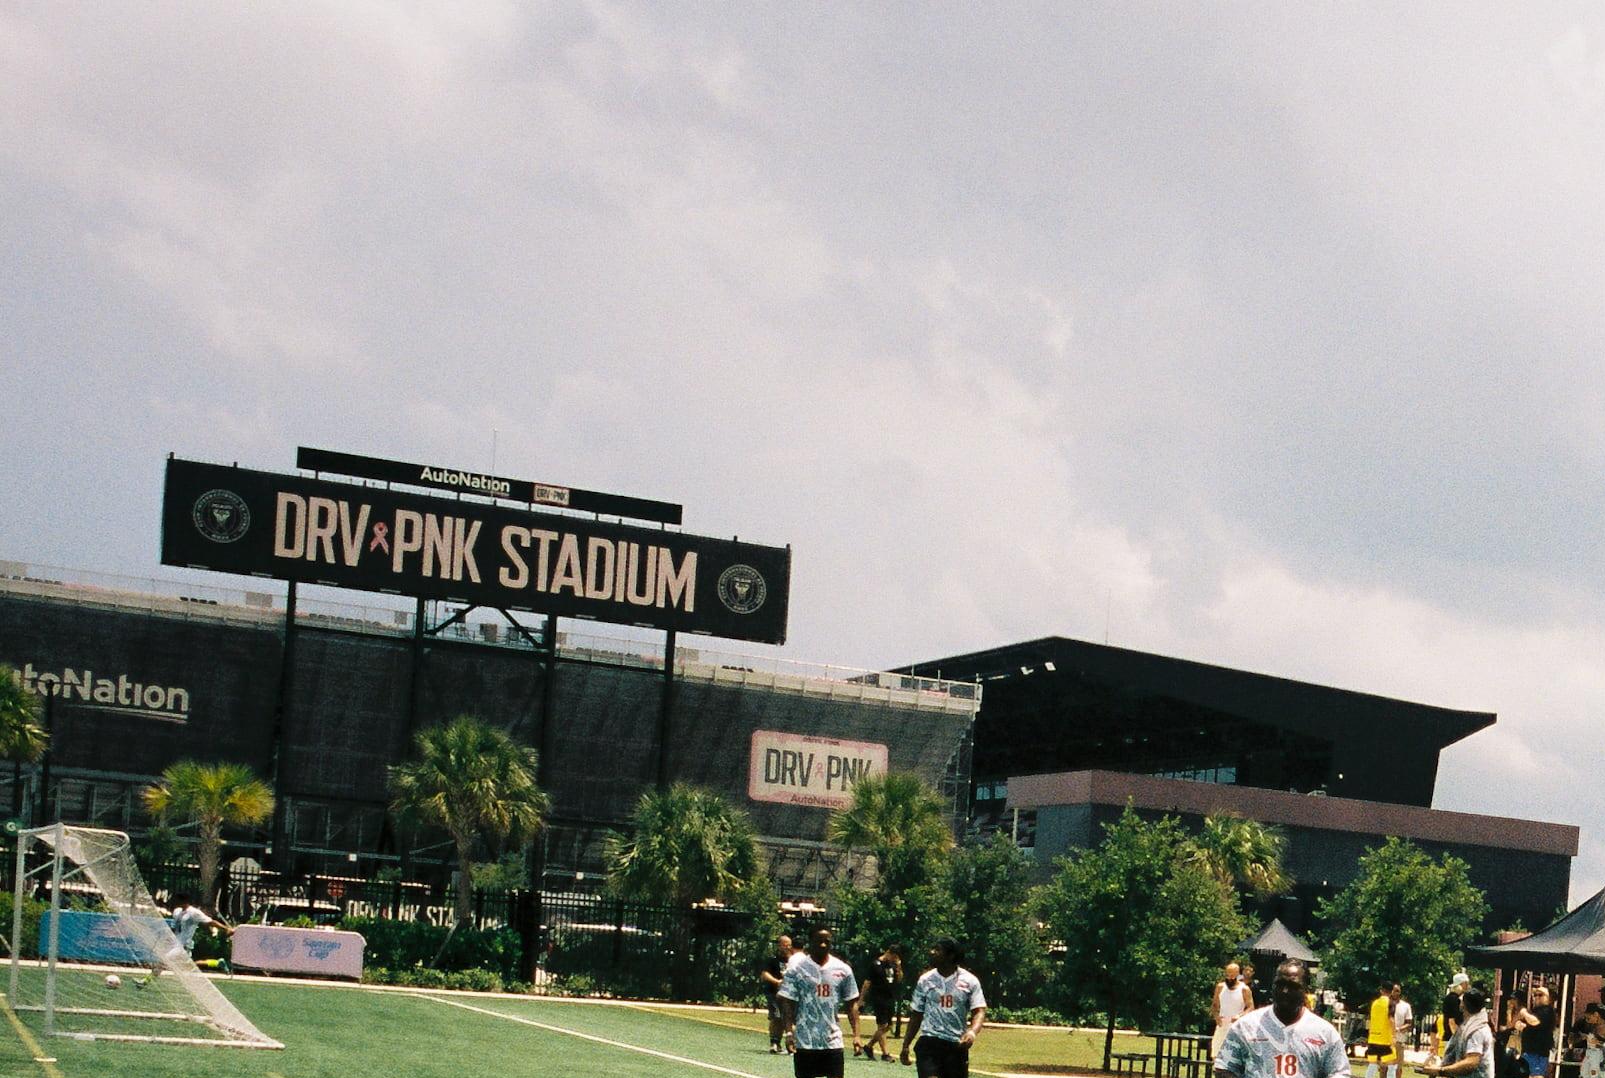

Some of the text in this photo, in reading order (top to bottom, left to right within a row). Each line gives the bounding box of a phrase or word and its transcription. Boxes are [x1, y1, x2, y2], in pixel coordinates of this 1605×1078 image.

[421, 467, 510, 493] AutoNation
[274, 491, 371, 567] DRV
[392, 508, 482, 584] PNK
[499, 525, 698, 612] STADIUM
[13, 663, 190, 712] toNation
[764, 748, 814, 787] DRV
[815, 983, 831, 998] 18
[939, 993, 954, 1008] 18
[1274, 1054, 1297, 1077] 18
